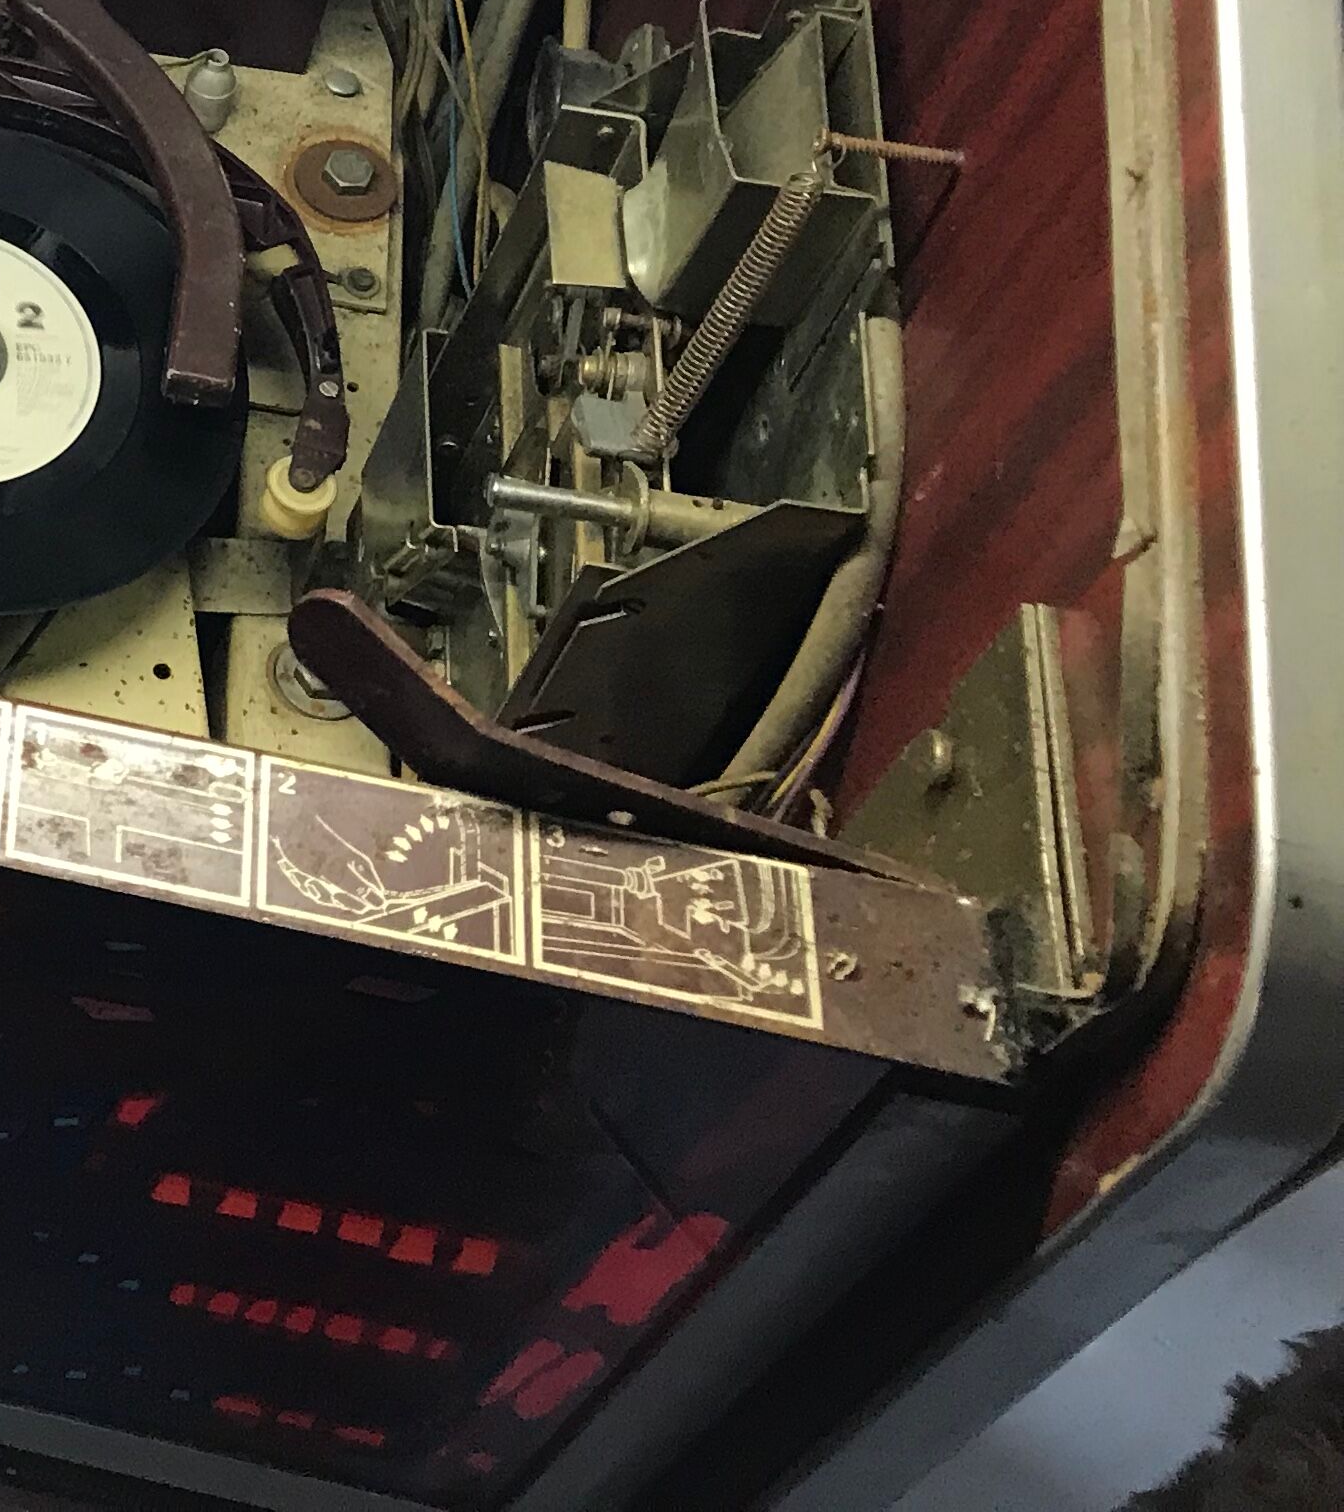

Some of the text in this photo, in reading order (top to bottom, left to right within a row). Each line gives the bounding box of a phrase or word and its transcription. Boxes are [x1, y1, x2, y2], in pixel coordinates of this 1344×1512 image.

[16, 301, 45, 330] 2
[278, 772, 297, 795] 2
[547, 826, 565, 848] 3
